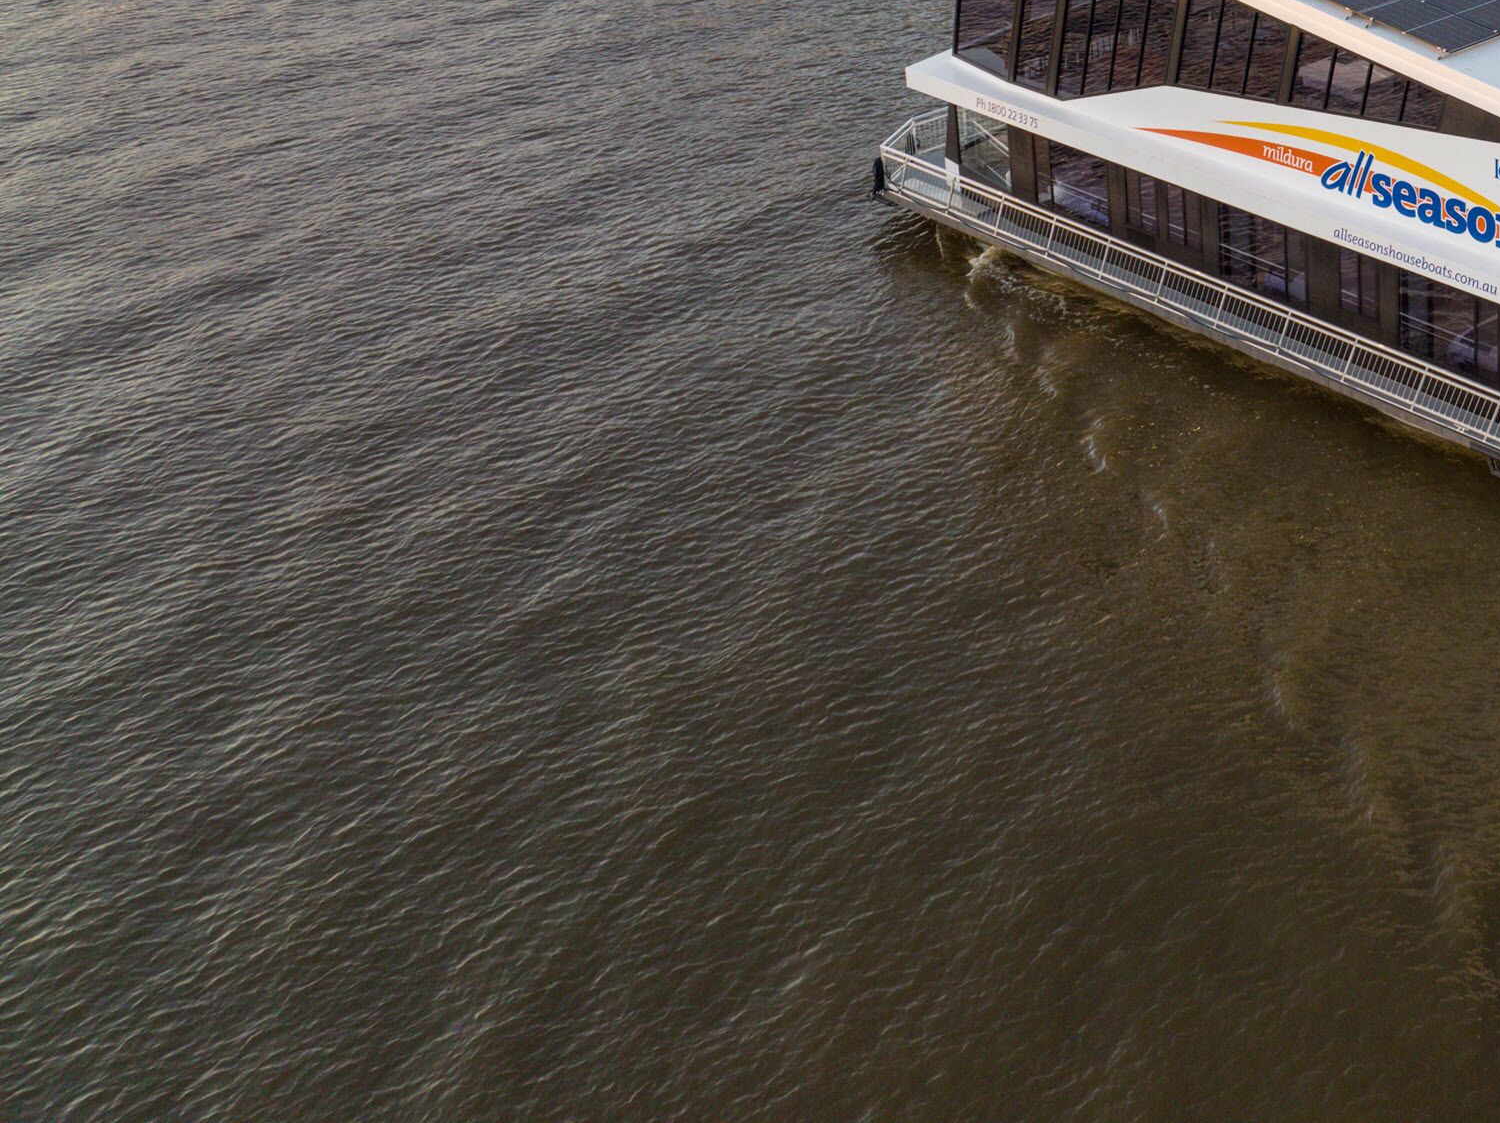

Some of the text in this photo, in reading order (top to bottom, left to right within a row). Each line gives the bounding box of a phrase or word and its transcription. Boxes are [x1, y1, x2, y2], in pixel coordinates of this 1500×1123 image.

[976, 97, 1039, 129] Ph 1800 22 33 75
[1263, 145, 1314, 173] mildura
[1333, 228, 1499, 296] allseasonshouseboats.com.au
